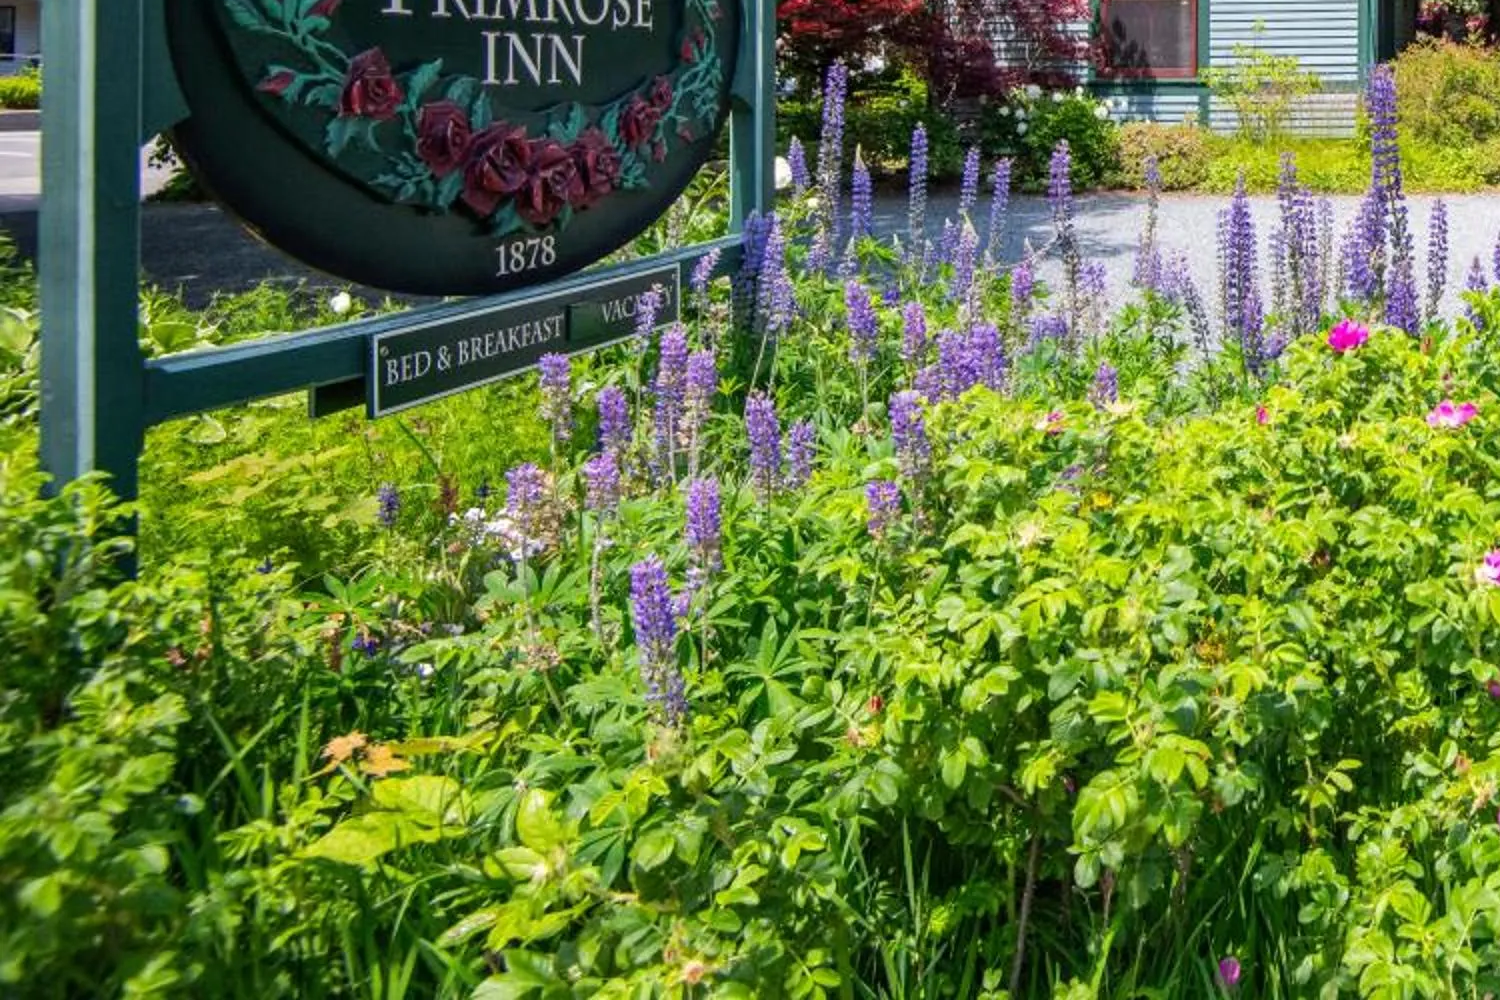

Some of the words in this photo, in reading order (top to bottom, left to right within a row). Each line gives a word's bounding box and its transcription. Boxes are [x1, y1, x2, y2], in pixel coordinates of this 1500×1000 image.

[480, 30, 585, 87] INN
[495, 235, 557, 277] 1878
[385, 351, 431, 385] BED
[437, 345, 451, 371] &
[457, 312, 565, 366] BREAKFAST
[601, 284, 673, 323] VACY
